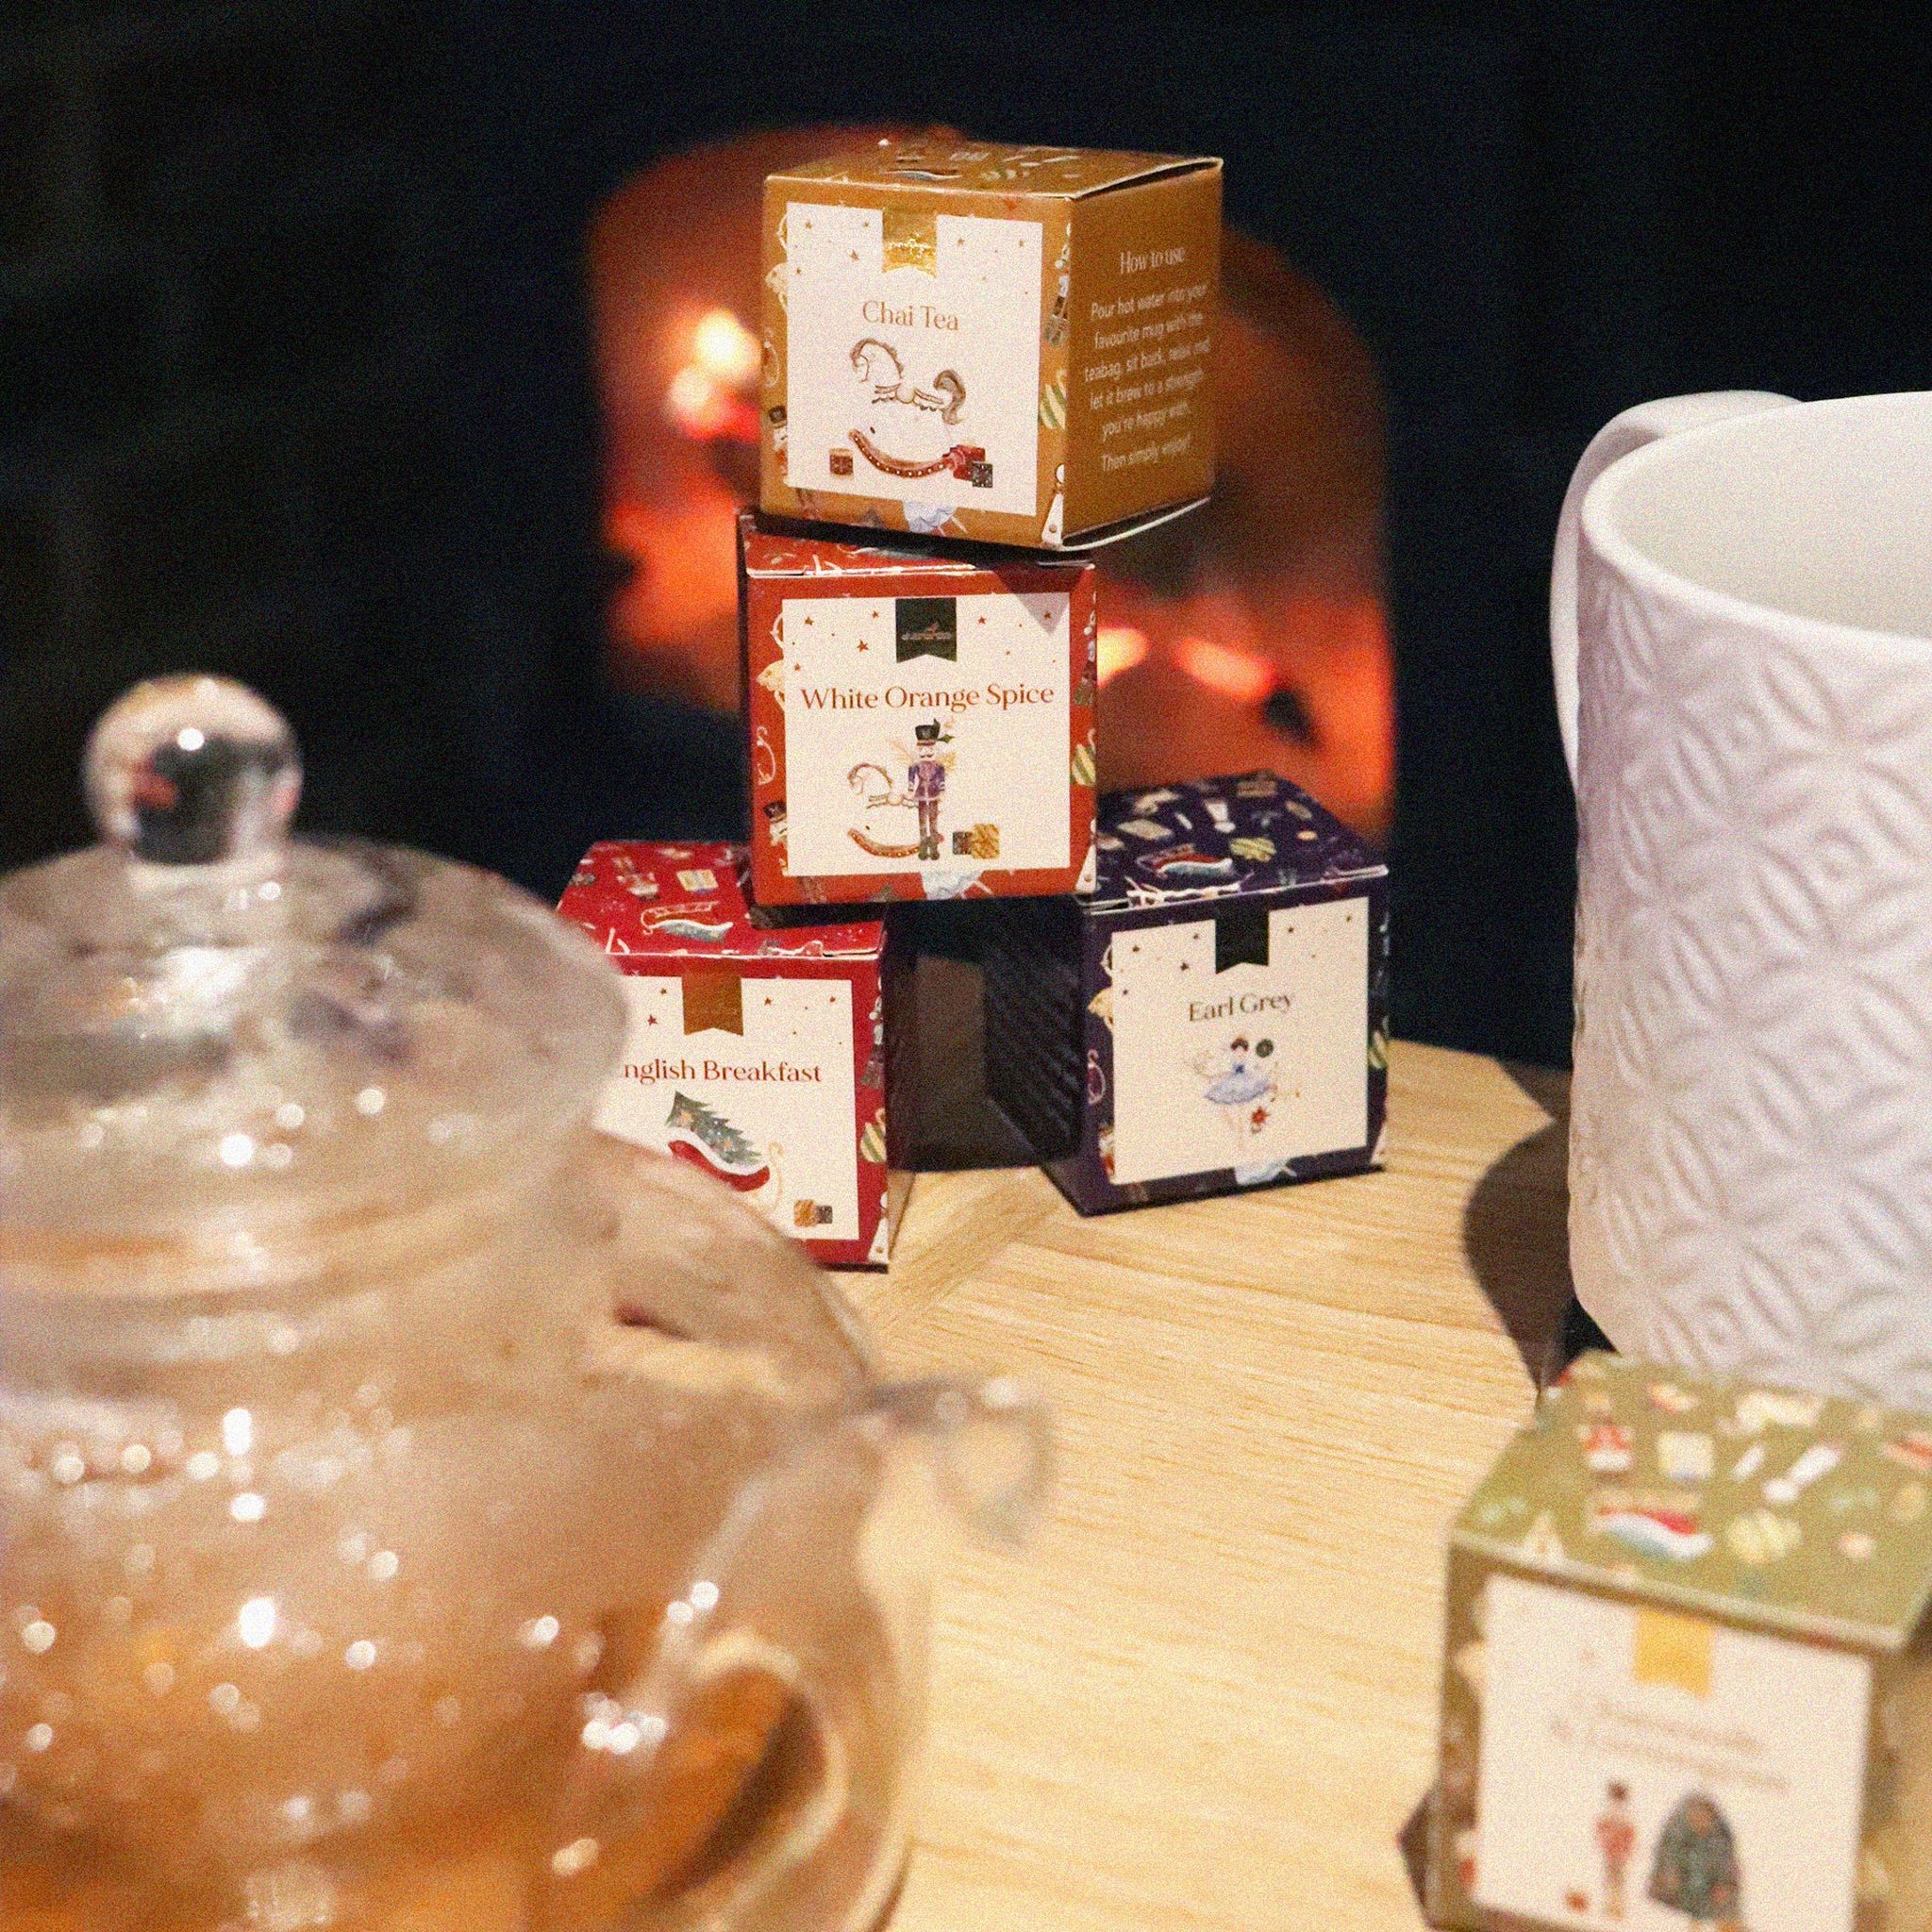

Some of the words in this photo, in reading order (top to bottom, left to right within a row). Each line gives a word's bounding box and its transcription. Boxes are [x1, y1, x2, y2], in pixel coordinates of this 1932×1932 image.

[1120, 250, 1147, 275] How
[1150, 250, 1163, 269] to
[1165, 247, 1185, 265] use
[862, 300, 913, 326] Chai
[921, 305, 959, 331] Tea
[1091, 302, 1115, 320] Pour
[1117, 296, 1135, 314] hot
[1137, 293, 1165, 310] water
[1094, 325, 1141, 349] favourite
[1141, 323, 1164, 341] mug
[1126, 355, 1138, 374] sit
[1090, 391, 1104, 410] let
[1106, 391, 1114, 406] it
[1116, 387, 1141, 404] brew
[1143, 382, 1155, 396] to
[1101, 454, 1126, 471] Then
[801, 688, 878, 709] White
[885, 687, 979, 713] Orange
[986, 683, 1055, 710] Spice
[1189, 996, 1234, 1022] Earl
[1240, 992, 1291, 1015] Grey
[624, 1058, 695, 1085] nglish
[704, 1060, 823, 1082] Breakfast
